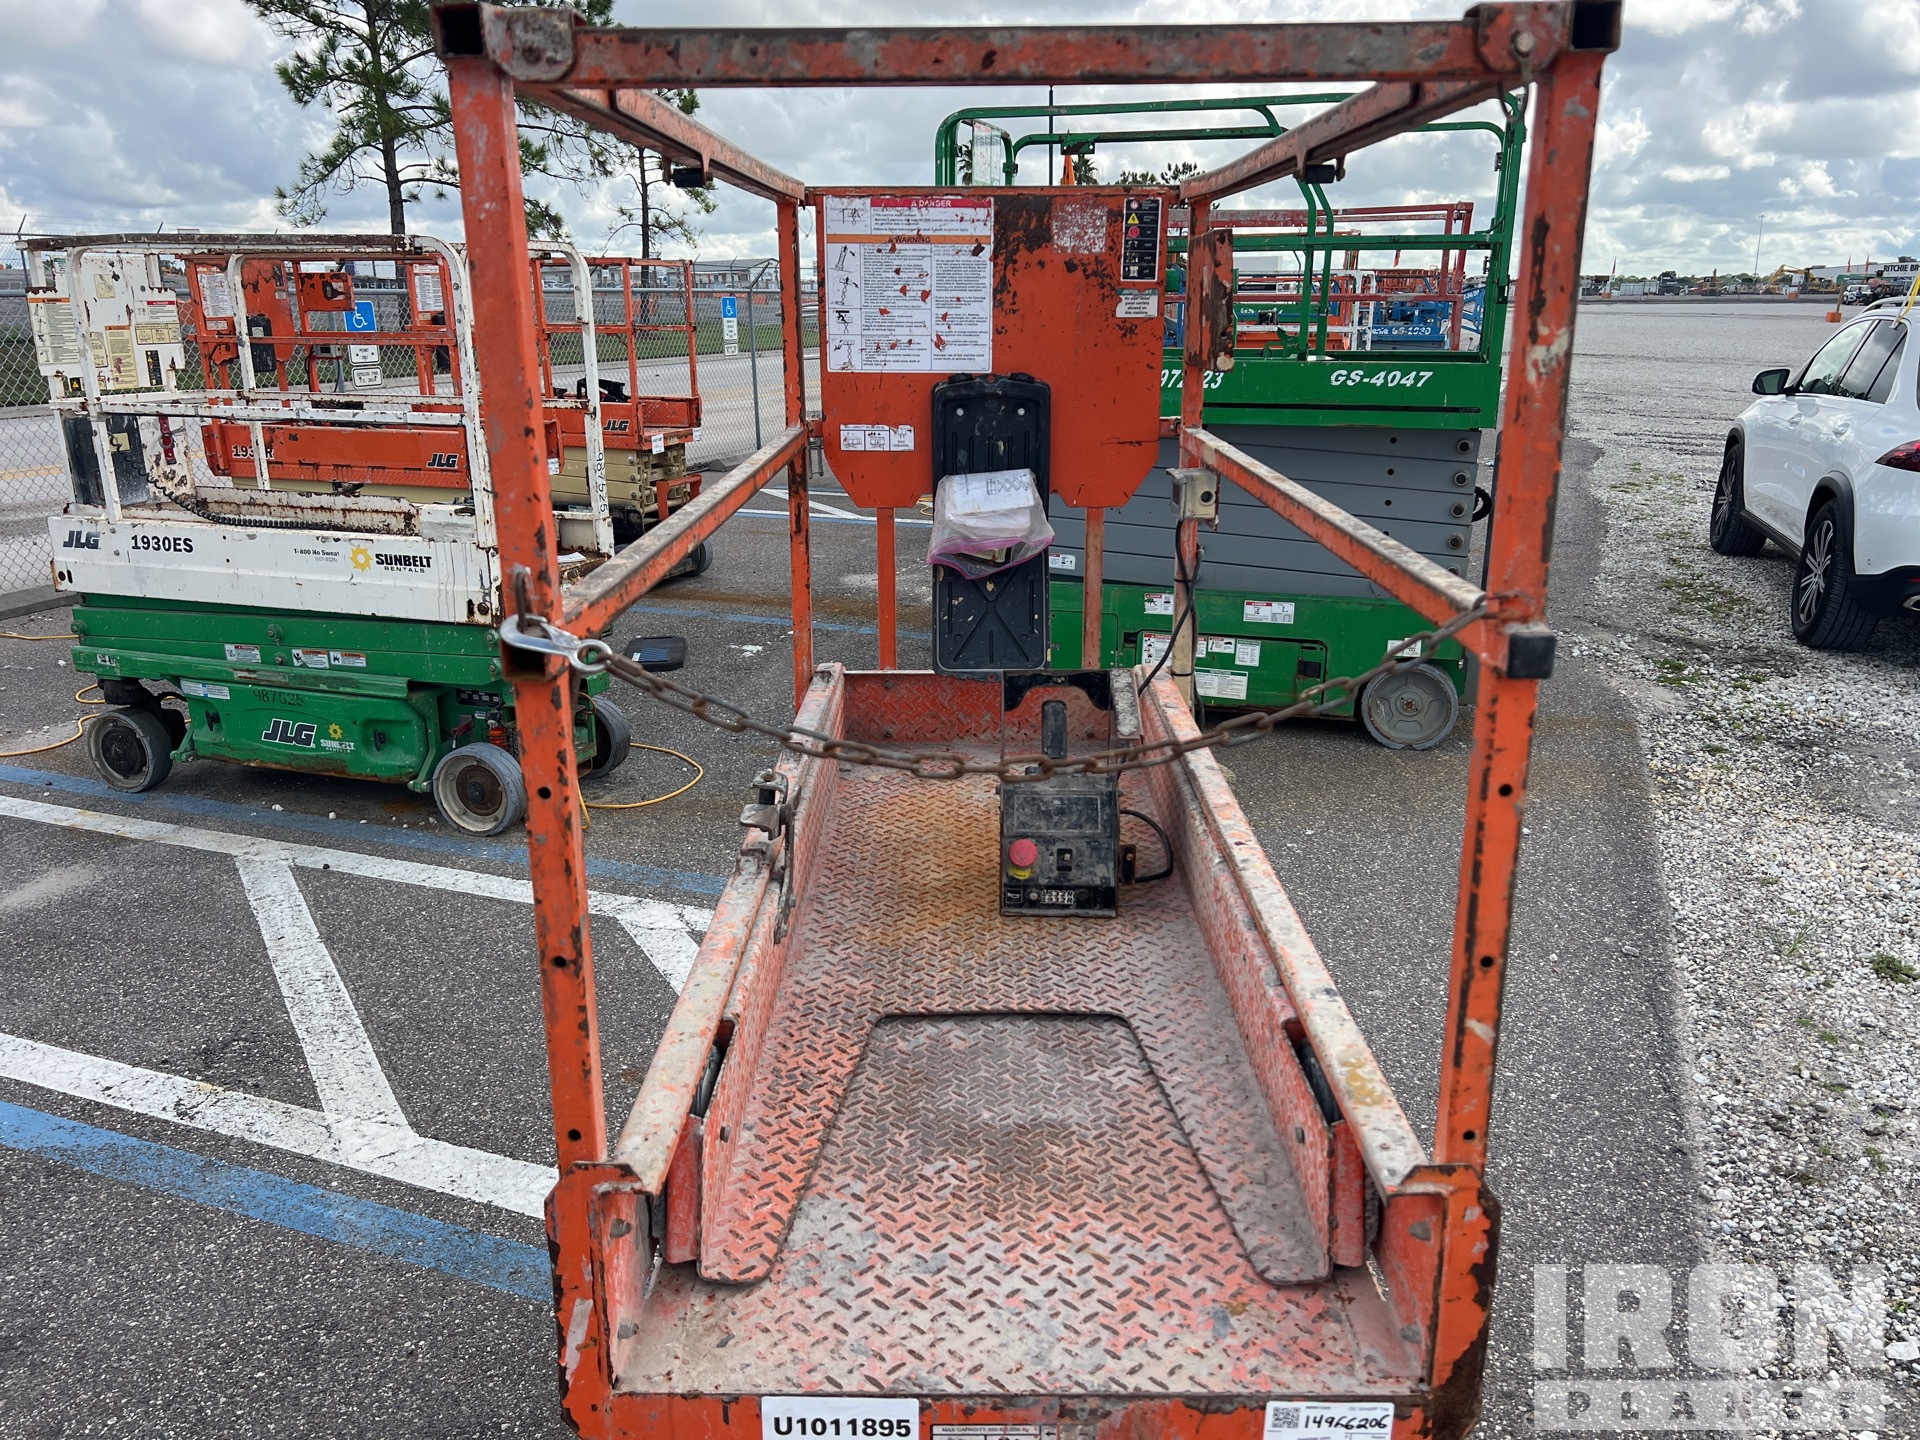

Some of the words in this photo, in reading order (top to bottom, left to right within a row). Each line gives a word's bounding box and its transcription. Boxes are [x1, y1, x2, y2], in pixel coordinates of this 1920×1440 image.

[1161, 369, 1224, 389] 9723
[1330, 370, 1434, 387] GS-4047
[603, 420, 630, 431] JLG
[232, 444, 274, 460] 193R
[427, 453, 458, 468] JLG
[596, 452, 608, 512] 987525
[63, 530, 100, 549] JLG
[131, 535, 194, 552] 1930ES
[375, 554, 432, 568] SUNBELT
[253, 688, 304, 706] 987525
[262, 718, 317, 748] JLG
[774, 1416, 911, 1438] U1011895
